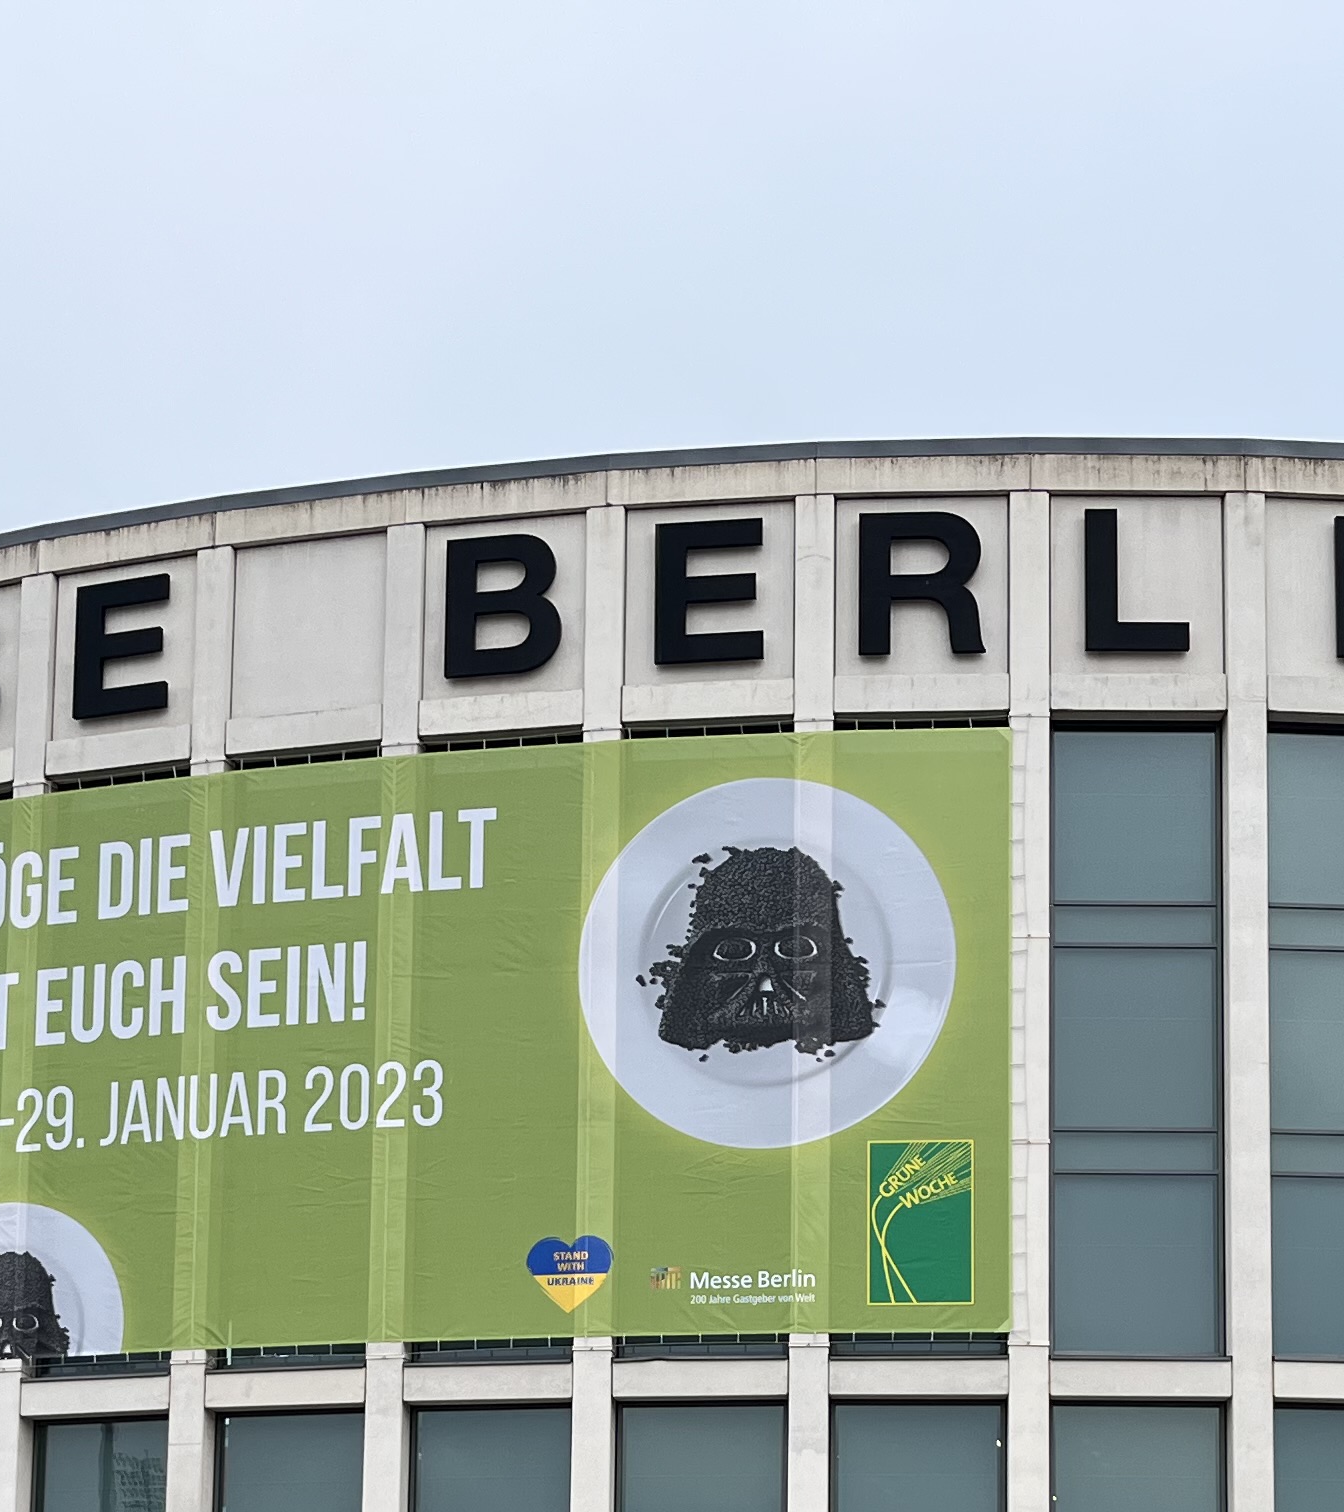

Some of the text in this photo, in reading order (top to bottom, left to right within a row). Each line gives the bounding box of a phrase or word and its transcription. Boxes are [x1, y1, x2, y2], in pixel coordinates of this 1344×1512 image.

[97, 833, 191, 920] DIE
[209, 807, 498, 908] VIELFALT
[34, 955, 187, 1047] EUCH
[206, 940, 367, 1031] SEIN!
[99, 1069, 287, 1147] JANUAR
[304, 1059, 444, 1133] 2023
[898, 1171, 959, 1209] WOCHE
[552, 1250, 589, 1262] STAND
[557, 1261, 586, 1272] WITH
[546, 1276, 595, 1287] UKRAINE
[689, 1268, 817, 1290] Messe Berlin
[690, 1294, 707, 1305] 200
[708, 1293, 731, 1305] Jahre
[732, 1292, 777, 1306] Gastgeber
[794, 1292, 816, 1303] Welt
